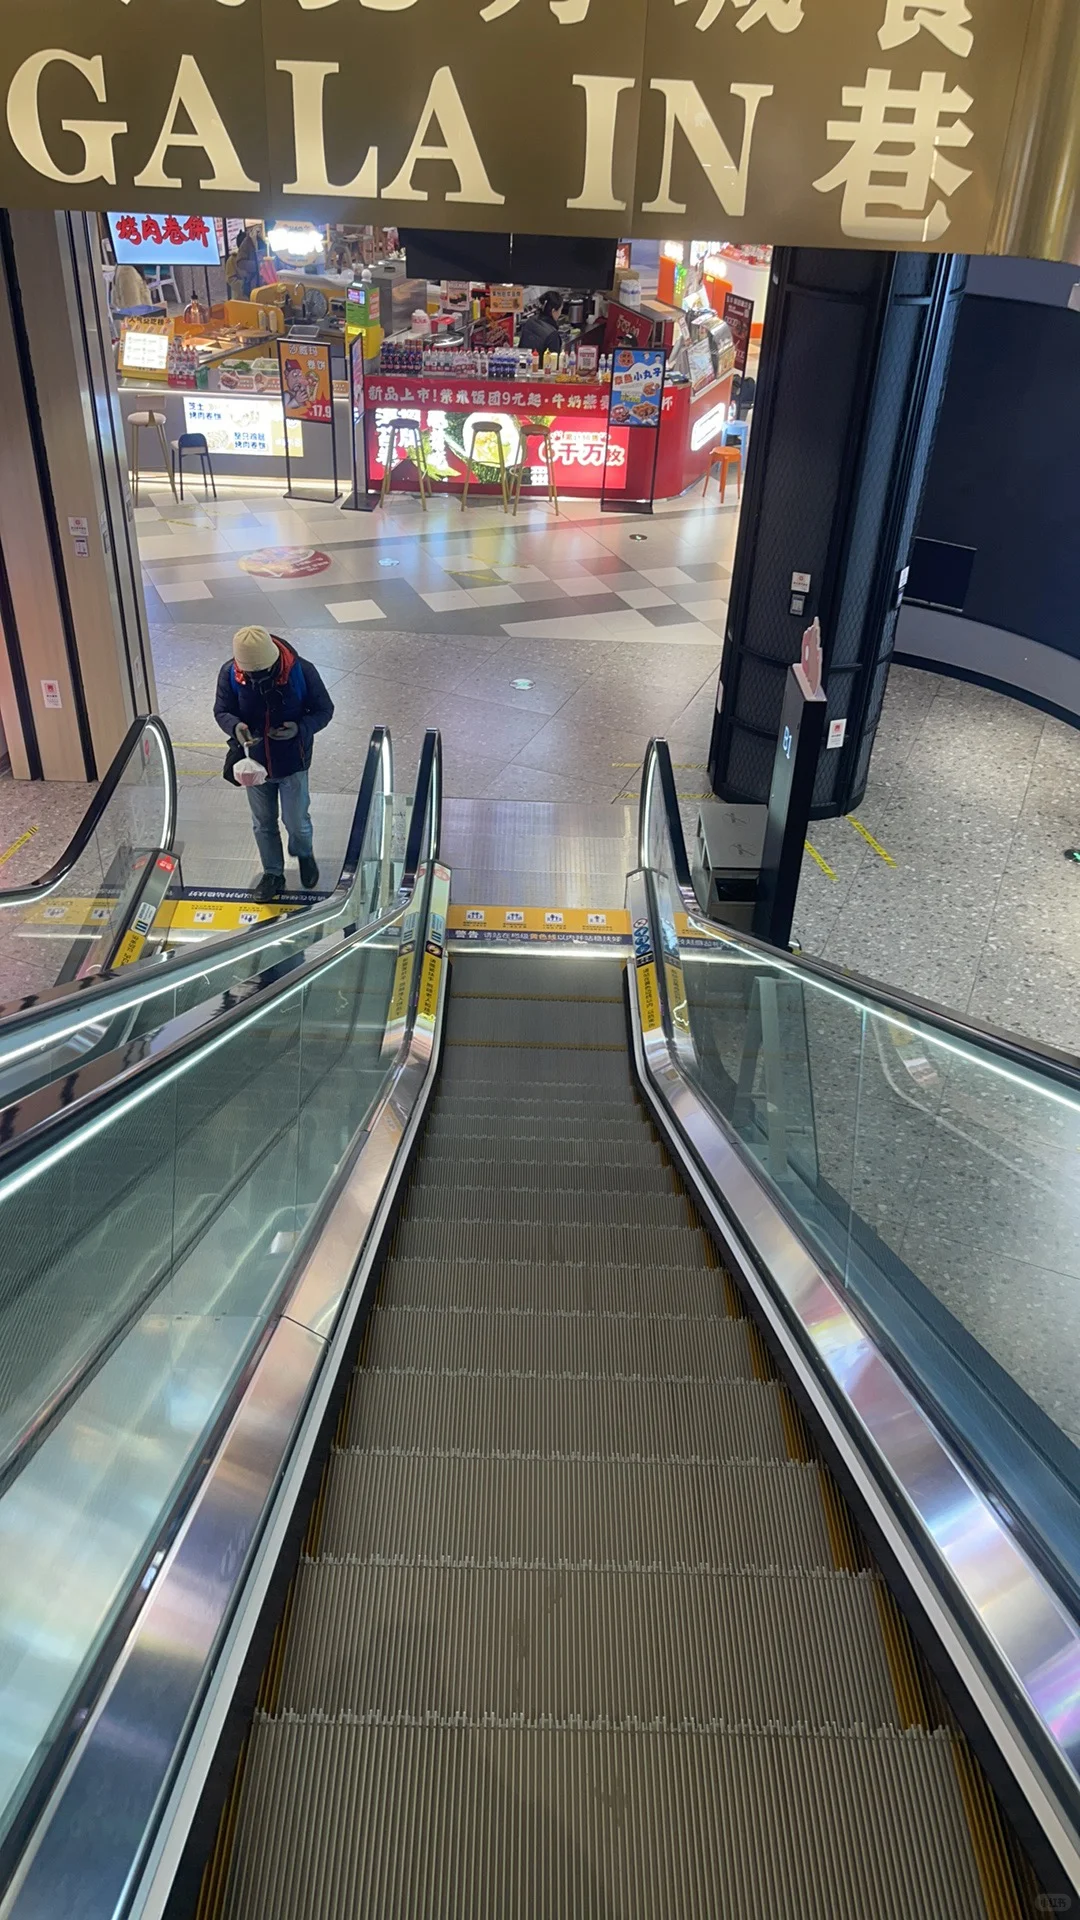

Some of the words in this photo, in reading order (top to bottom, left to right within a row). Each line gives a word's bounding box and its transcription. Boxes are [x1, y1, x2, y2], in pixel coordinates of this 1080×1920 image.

[7, 48, 506, 205] GALA
[566, 74, 774, 216] IN
[116, 214, 210, 248] 烤肉卷饼
